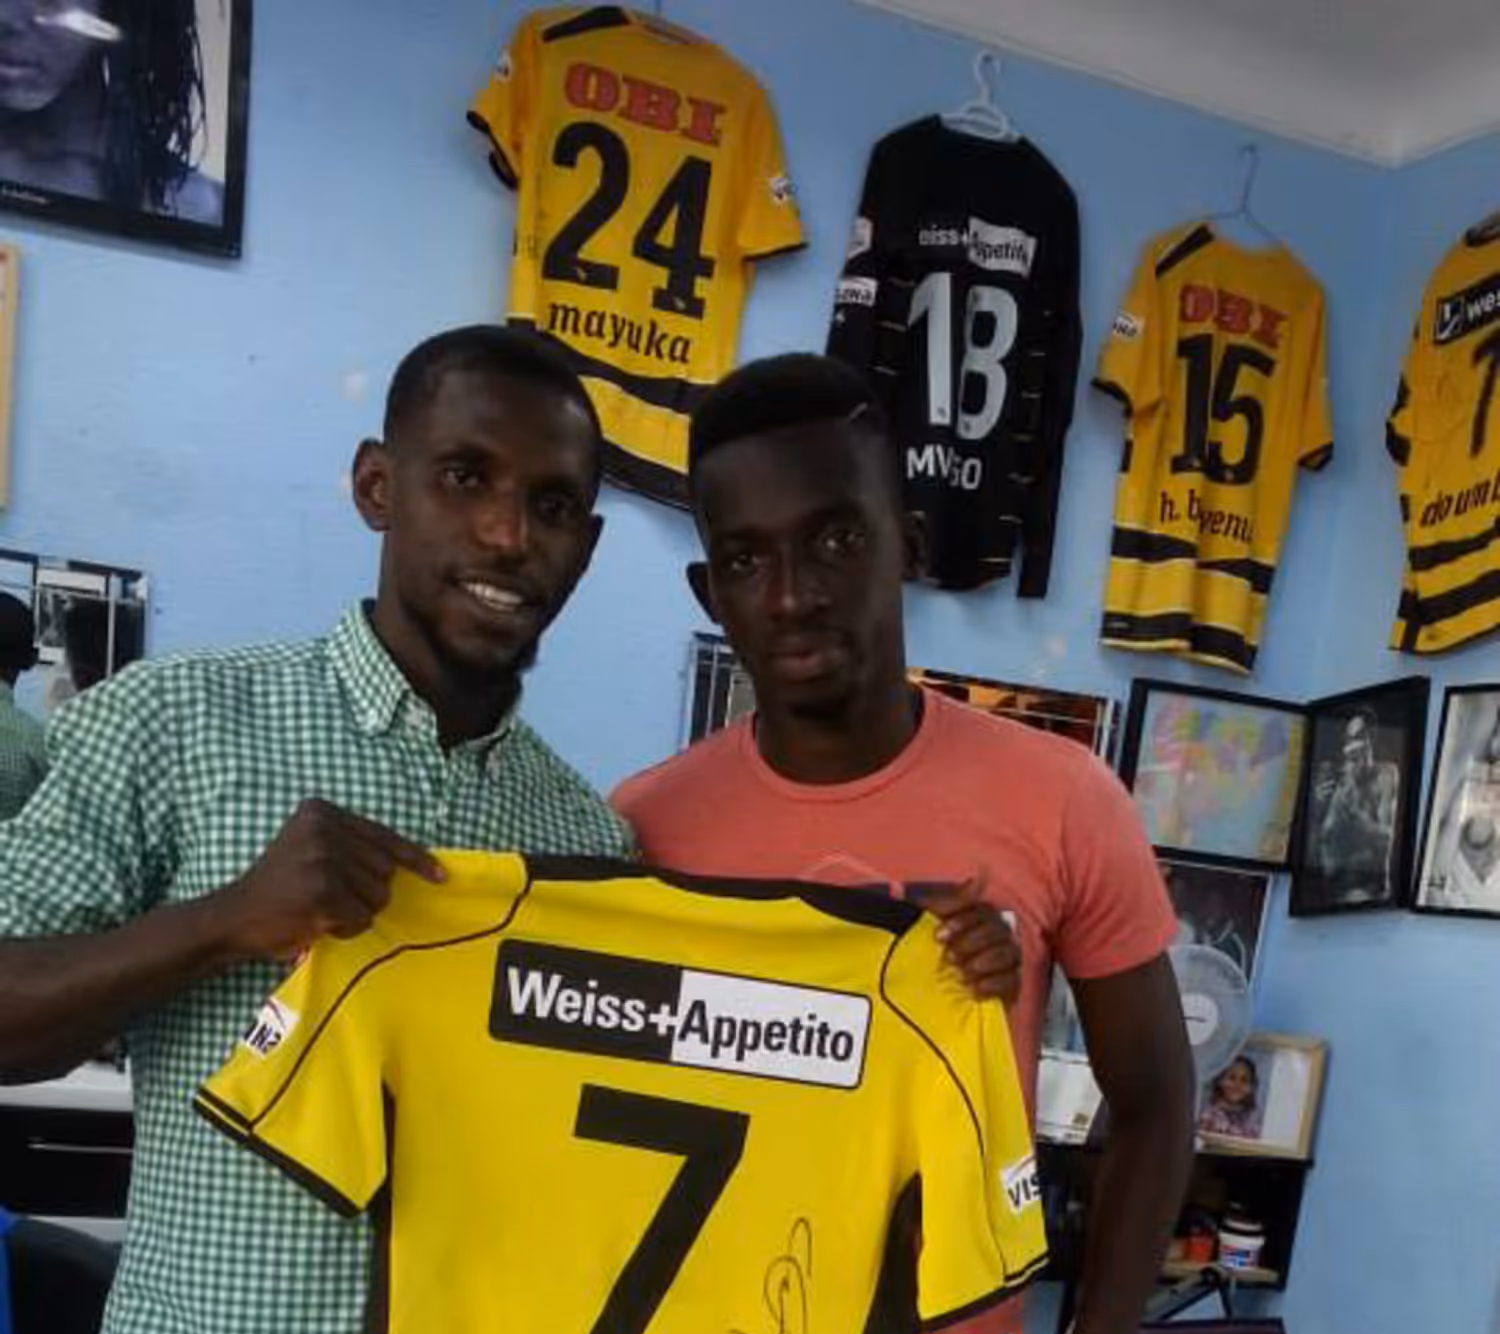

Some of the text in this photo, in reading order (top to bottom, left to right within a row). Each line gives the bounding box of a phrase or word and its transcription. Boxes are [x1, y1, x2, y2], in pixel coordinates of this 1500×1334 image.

[563, 61, 727, 147] OBI
[541, 121, 715, 321] 24
[548, 301, 693, 365] mayuka
[907, 271, 1018, 440] 18
[1179, 283, 1289, 350] OBI
[1170, 332, 1277, 485] 15
[506, 965, 855, 1062] Weiss+Appetito
